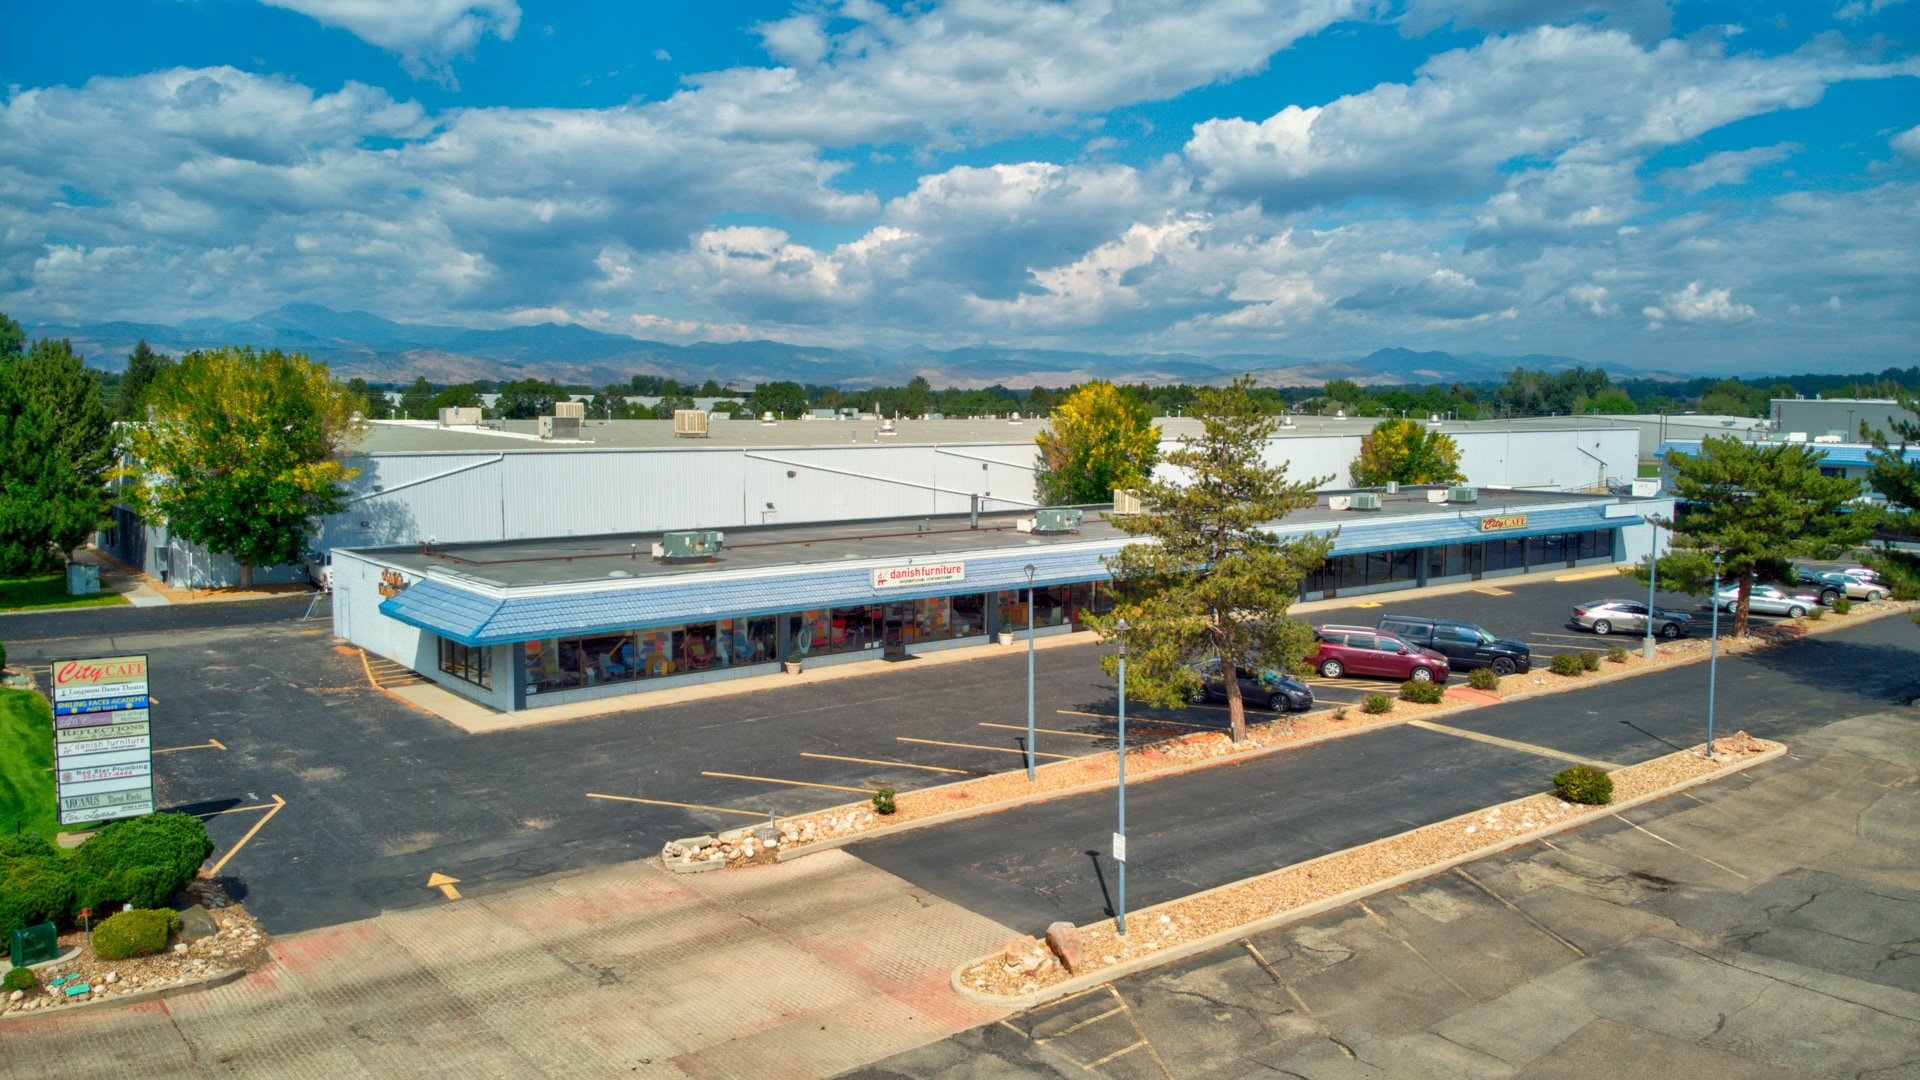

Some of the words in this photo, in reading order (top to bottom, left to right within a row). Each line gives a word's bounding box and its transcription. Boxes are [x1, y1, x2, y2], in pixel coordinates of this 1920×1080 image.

[1484, 517, 1503, 530] City
[1503, 516, 1526, 527] CAFE
[890, 568, 920, 579] danish
[921, 564, 962, 576] furniture
[57, 661, 103, 684] City
[105, 663, 145, 676] CAFE
[69, 687, 100, 695] Longmont
[57, 701, 87, 709] SMILING
[111, 696, 146, 705] ACADEMY
[62, 724, 145, 737] REFLECTIONS
[75, 741, 104, 750] danish
[106, 737, 146, 747] furniture
[112, 764, 148, 772] Plumbing
[64, 795, 100, 809] ARCANUS
[63, 811, 82, 822] For
[84, 808, 117, 820] Lease
